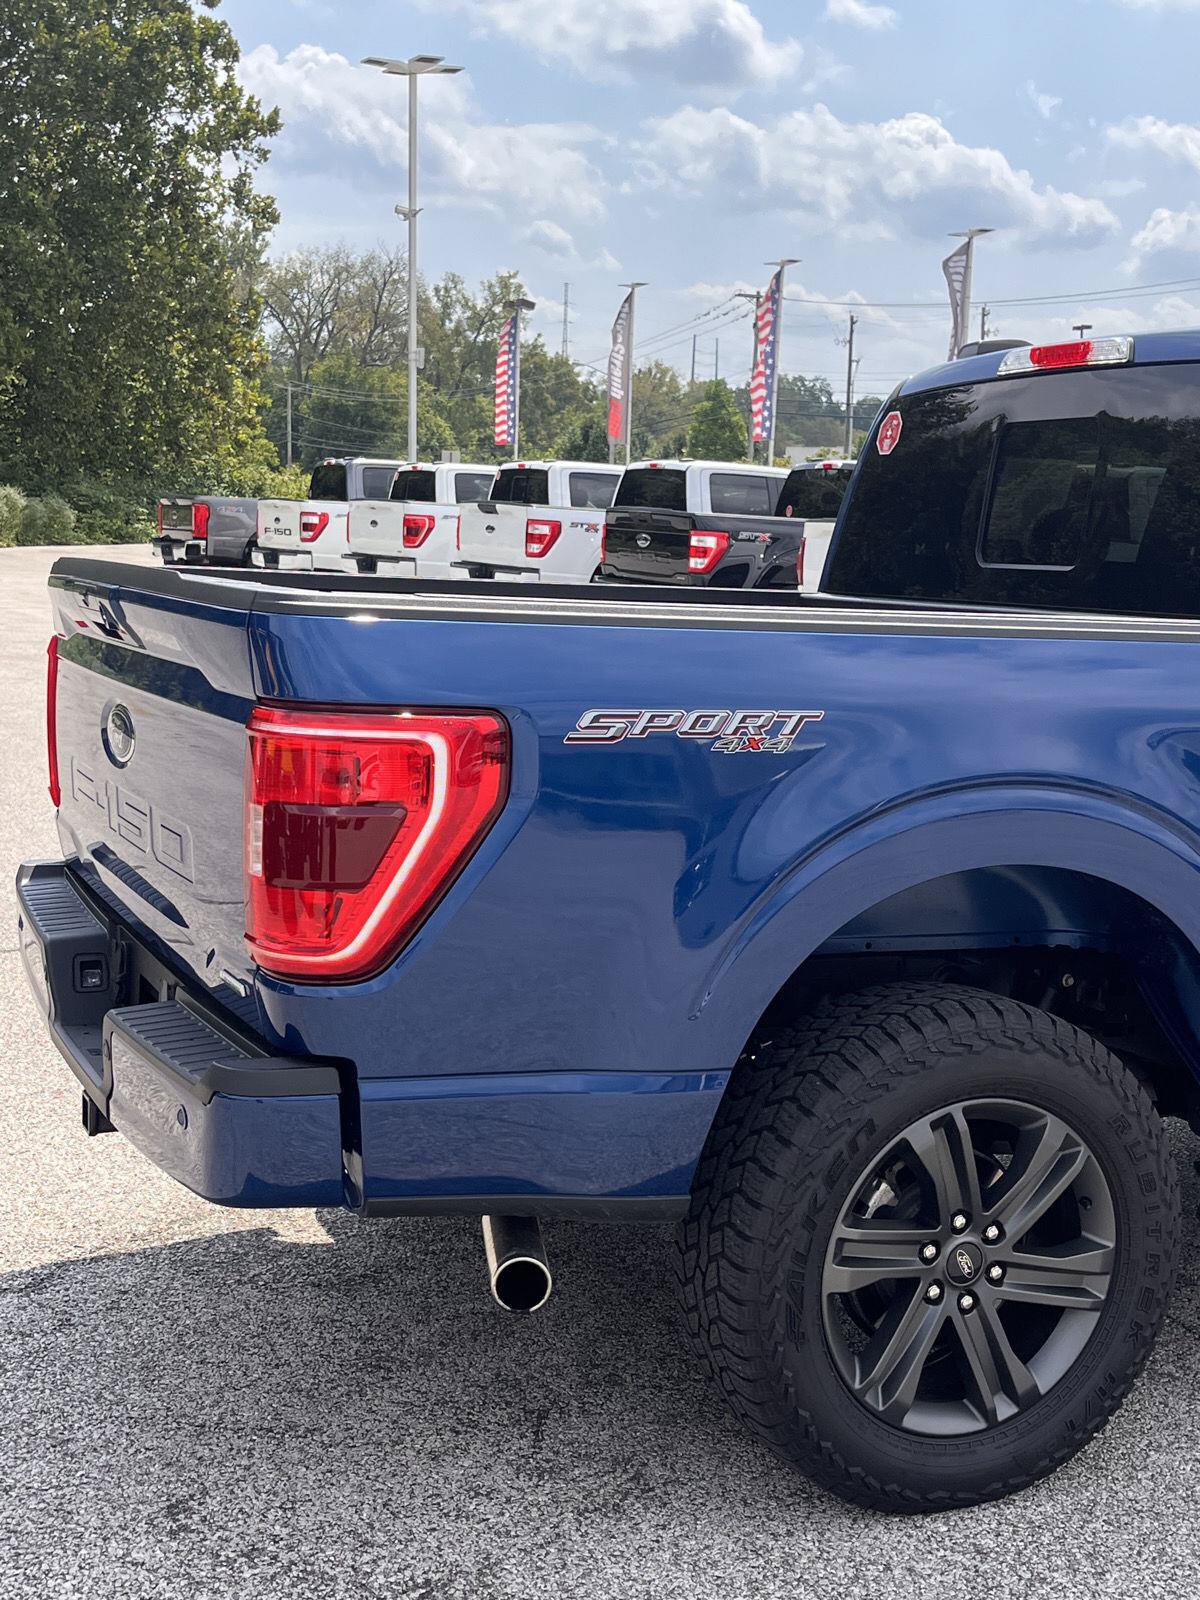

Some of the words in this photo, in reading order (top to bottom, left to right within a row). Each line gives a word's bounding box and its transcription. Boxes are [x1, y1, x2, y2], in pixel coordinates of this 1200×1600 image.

[264, 527, 292, 536] F-150
[737, 531, 773, 542] STX
[563, 708, 825, 744] SPORT
[710, 736, 794, 754] 4x4
[71, 755, 195, 885] F-150
[1108, 1113, 1162, 1349] RUBITREK
[958, 1253, 973, 1276] Ford
